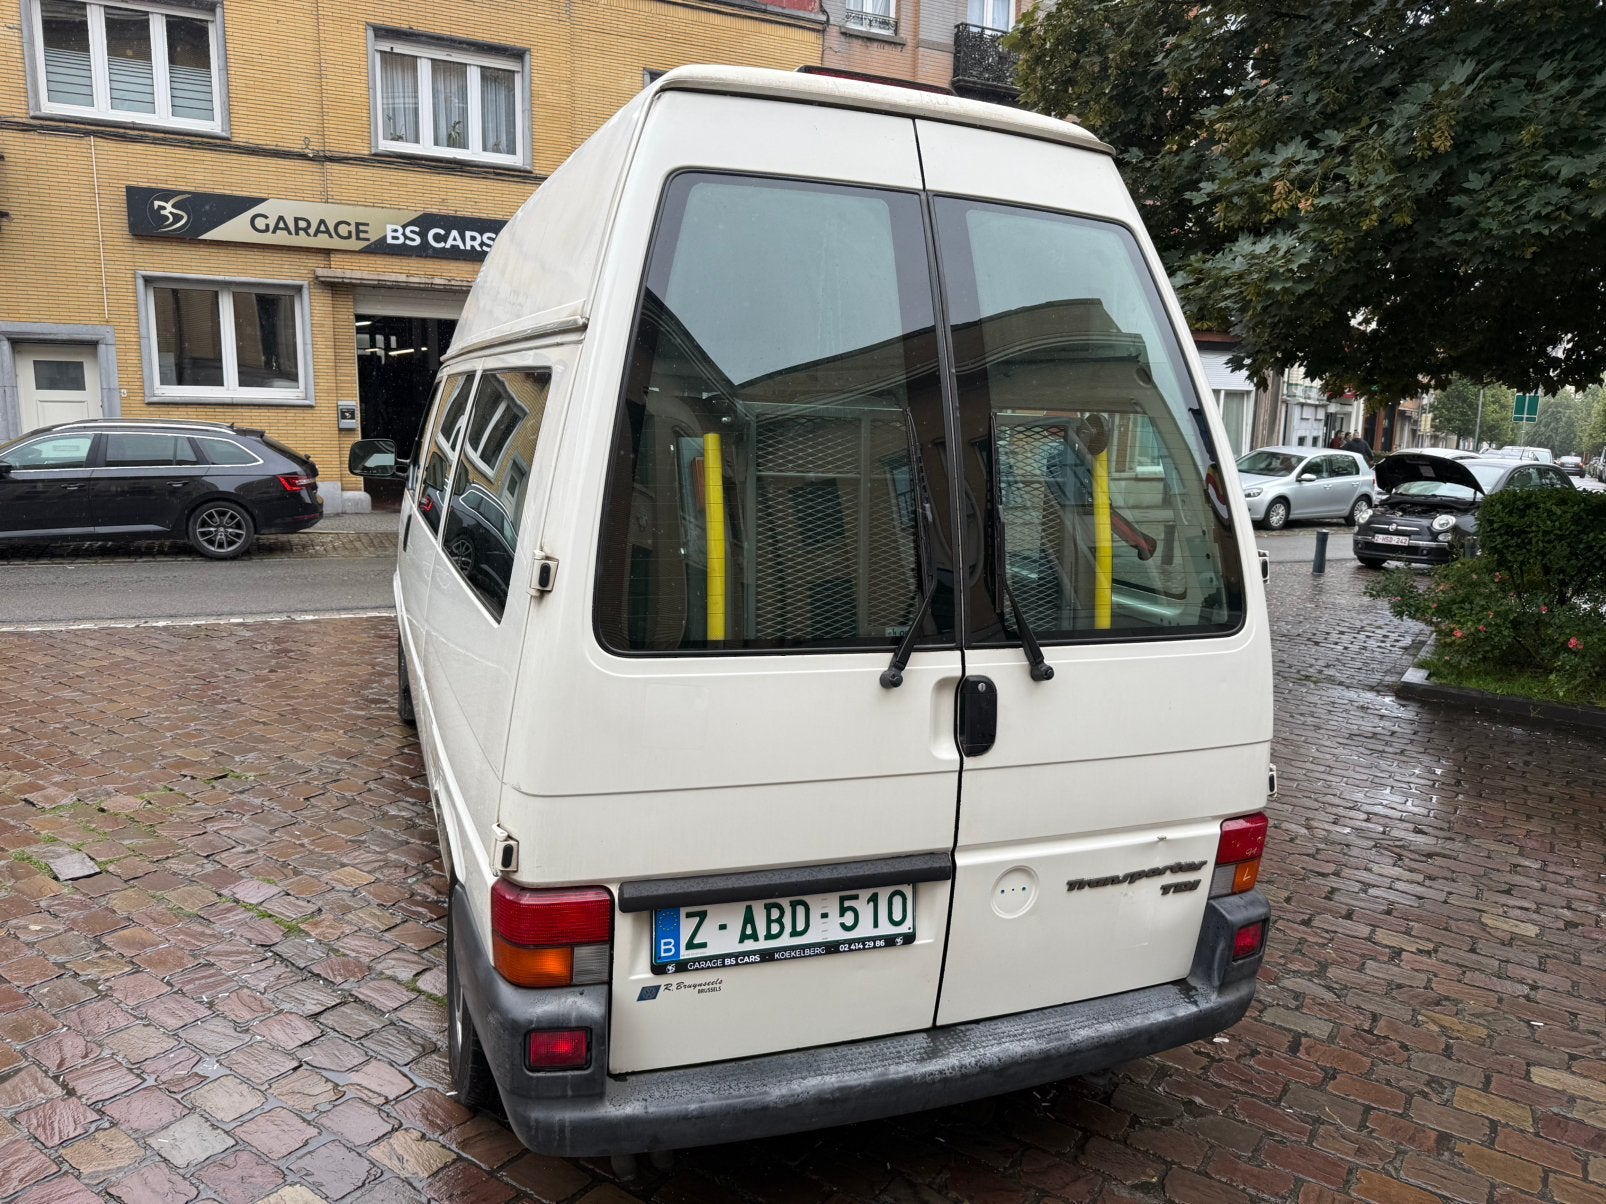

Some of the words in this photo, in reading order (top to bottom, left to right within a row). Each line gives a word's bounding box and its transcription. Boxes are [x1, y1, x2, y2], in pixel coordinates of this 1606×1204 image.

[249, 213, 371, 242] GARAGE
[386, 223, 421, 246] BS
[428, 227, 496, 252] CARS
[1066, 860, 1208, 892] Transporter
[1160, 879, 1201, 896] TDI
[660, 938, 675, 957] B
[687, 959, 723, 970] GARAGE
[725, 957, 736, 966] BS
[738, 954, 760, 964] CARS
[774, 946, 826, 960] KOEKELBERG
[839, 944, 849, 952] 02
[850, 941, 863, 950] 414
[864, 940, 874, 949] 29
[875, 939, 885, 947] 86
[697, 986, 722, 994] BRUSSELS
